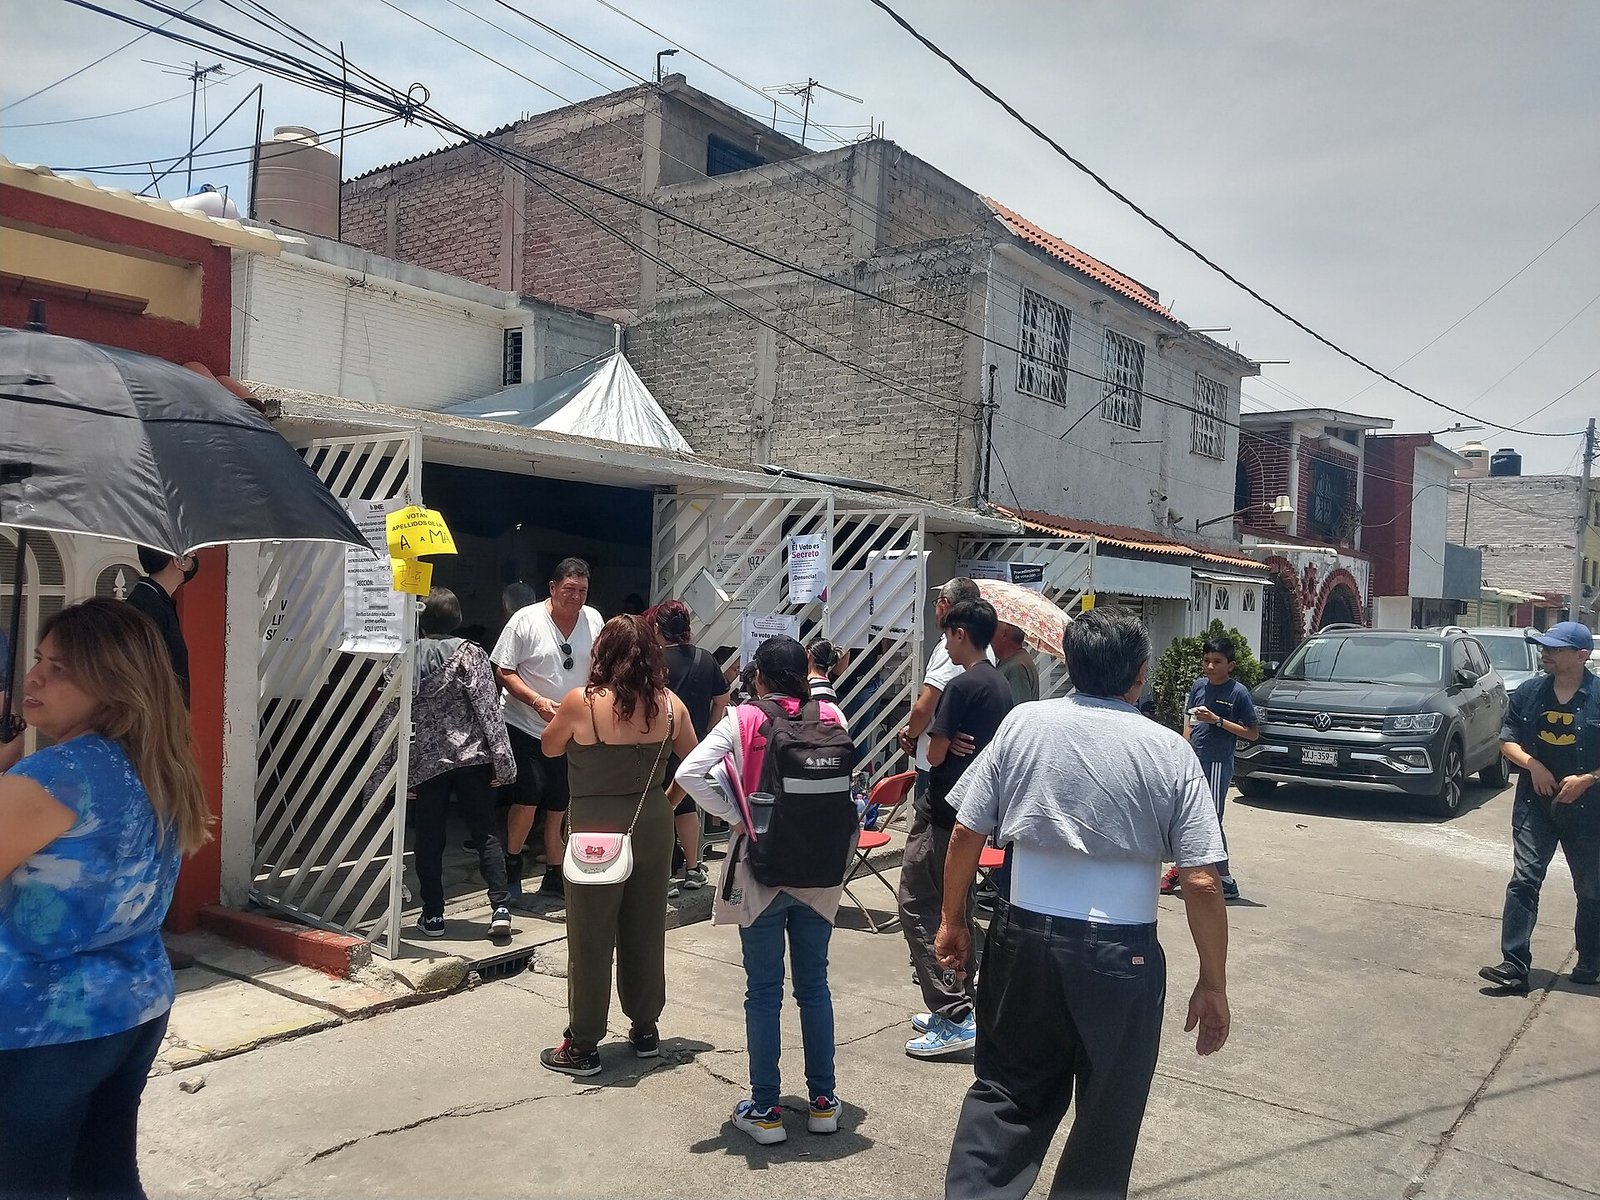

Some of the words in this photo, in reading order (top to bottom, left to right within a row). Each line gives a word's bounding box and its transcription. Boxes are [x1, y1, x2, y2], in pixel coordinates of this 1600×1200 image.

[392, 521, 427, 531] APELLIDOS
[400, 534, 411, 550] A
[791, 550, 820, 559] Secreto
[816, 757, 840, 766] INE
